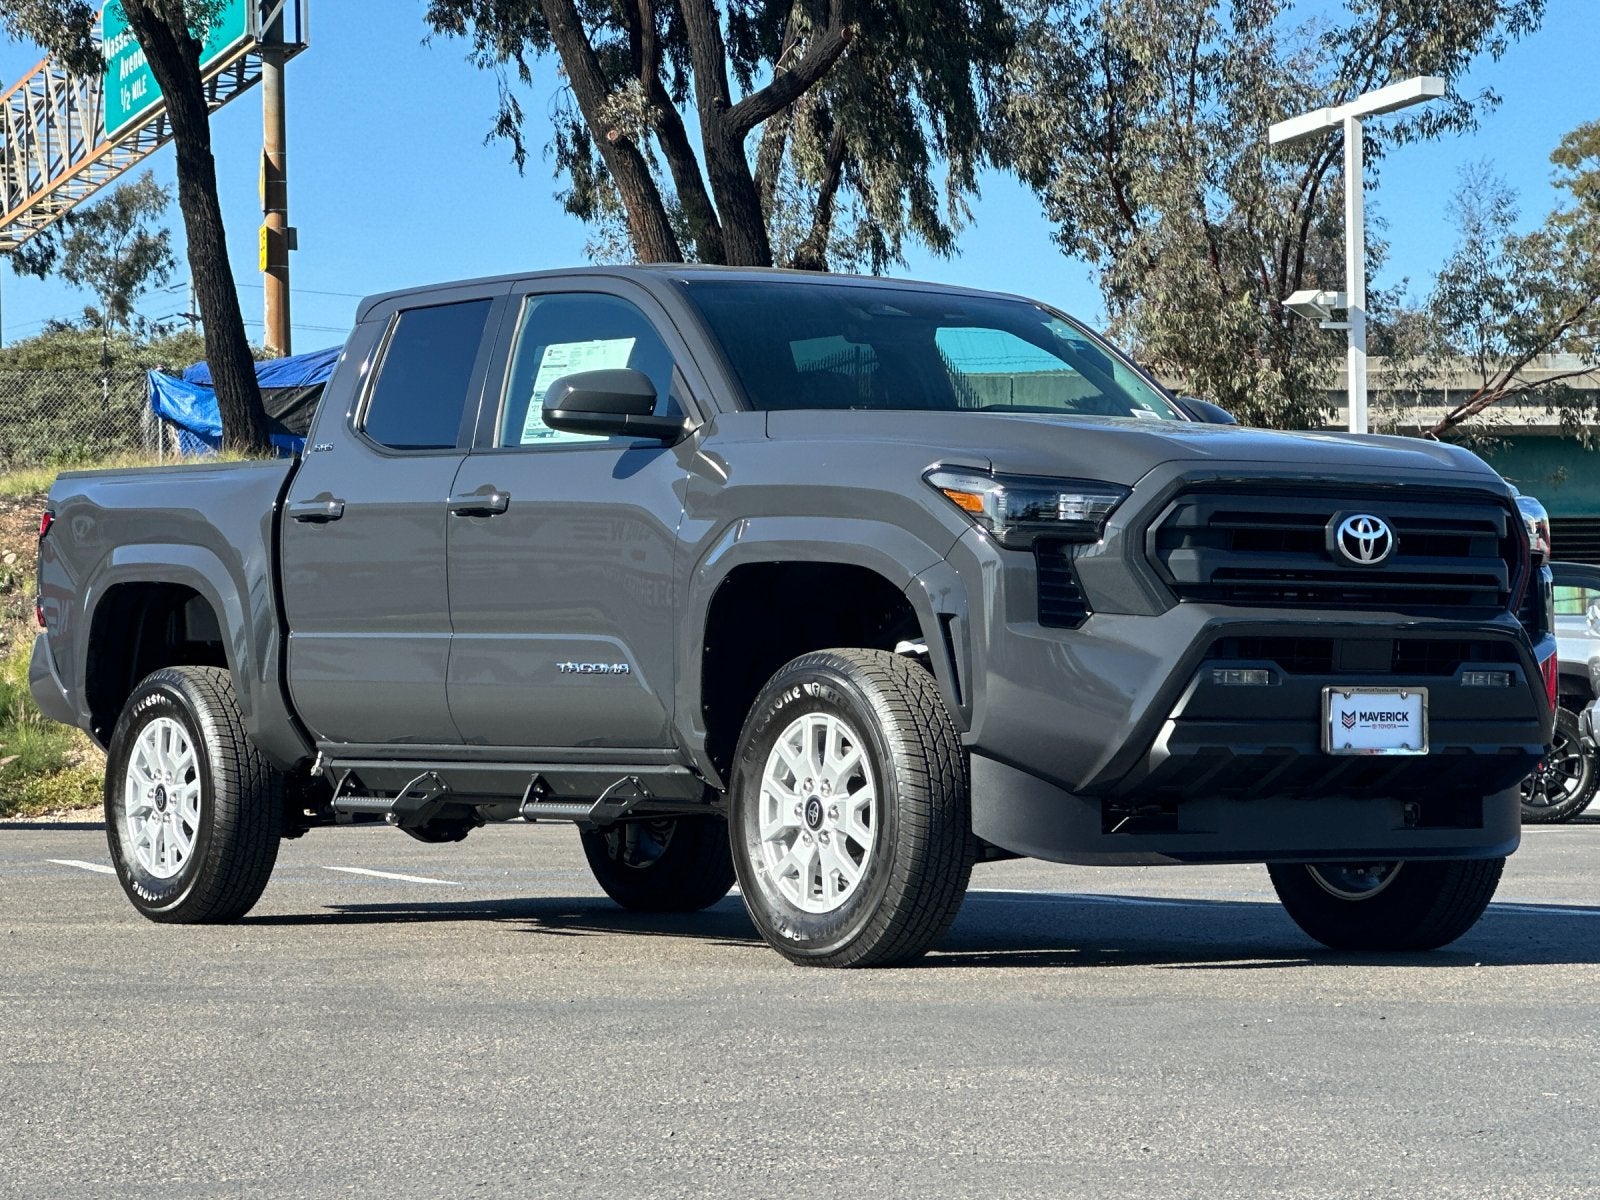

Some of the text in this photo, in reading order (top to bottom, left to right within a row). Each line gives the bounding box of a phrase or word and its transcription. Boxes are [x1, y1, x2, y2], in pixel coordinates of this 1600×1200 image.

[132, 74, 147, 101] MILE
[556, 662, 630, 674] TACOMA
[1359, 711, 1409, 722] MAVERICK
